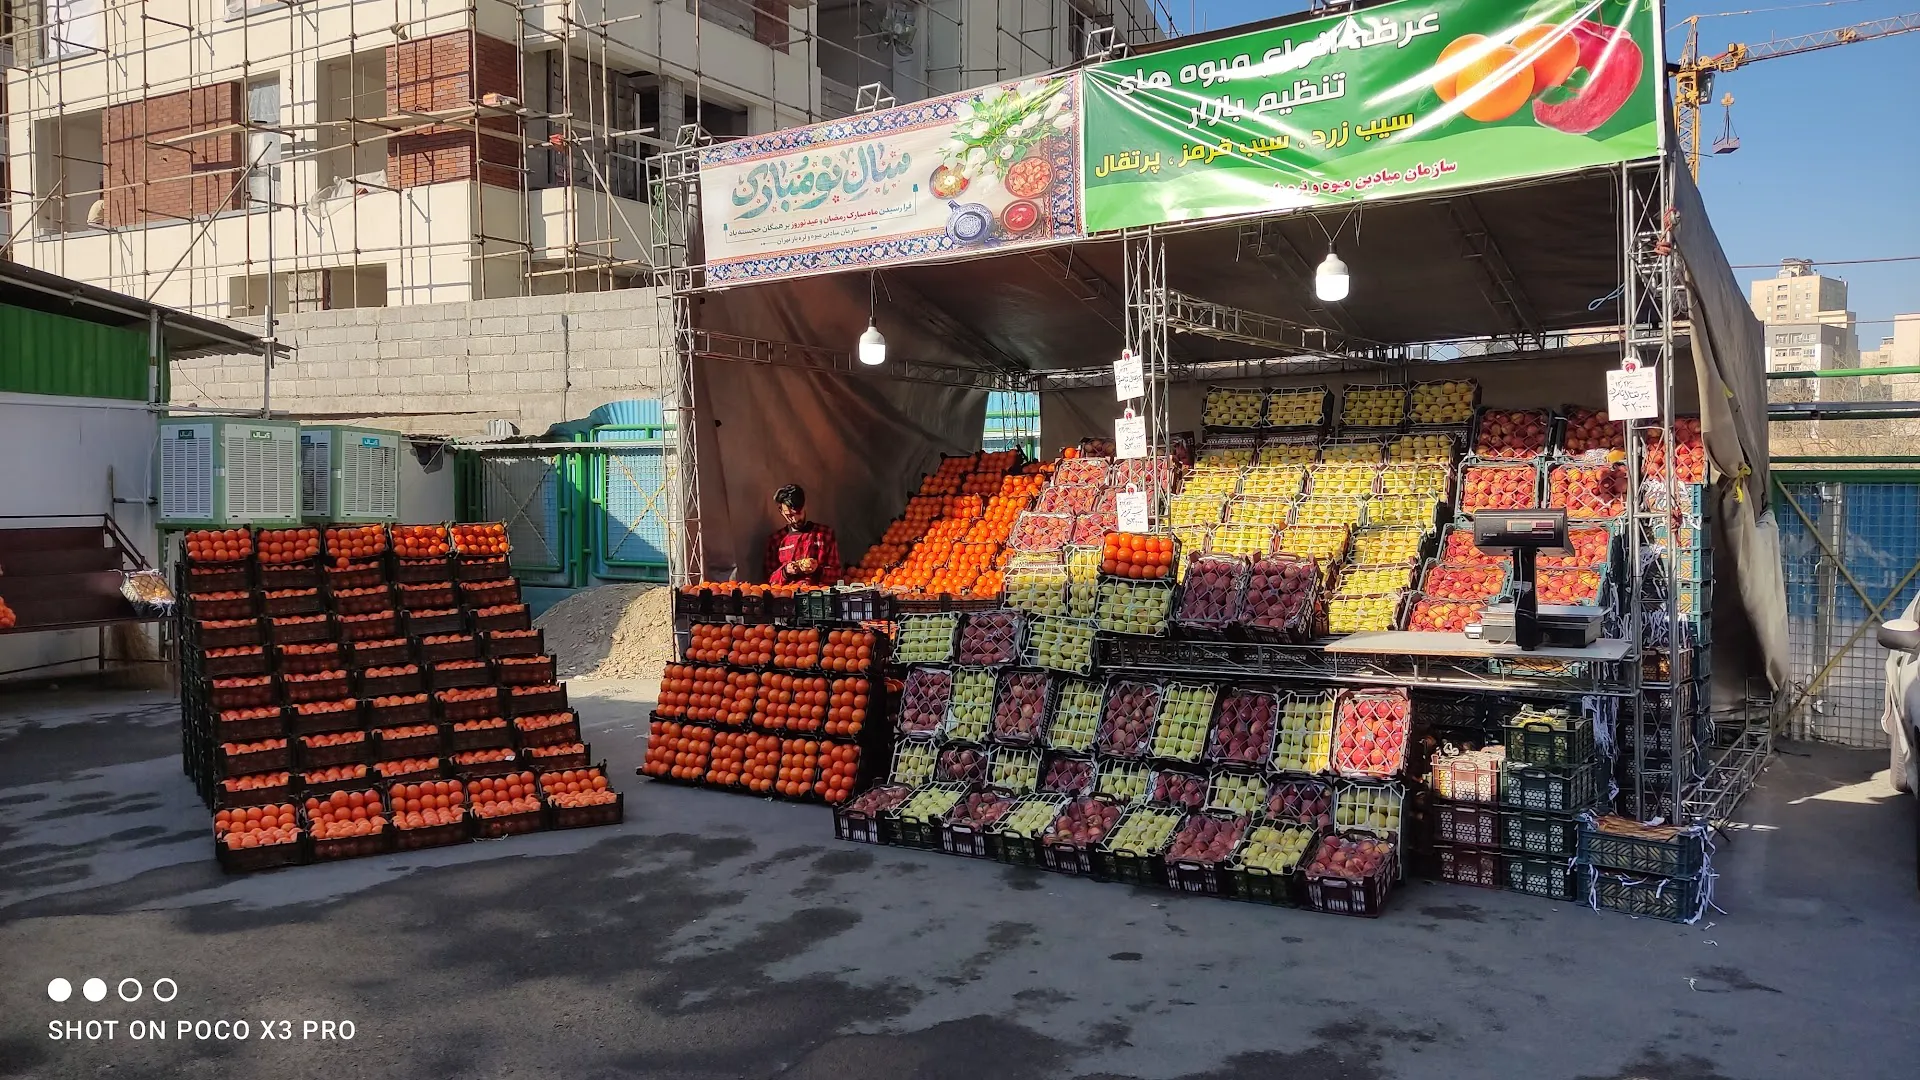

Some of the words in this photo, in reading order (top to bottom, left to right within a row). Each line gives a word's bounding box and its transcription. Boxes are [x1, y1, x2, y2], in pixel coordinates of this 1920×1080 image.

[1116, 68, 1173, 96] های
[1179, 53, 1251, 88] میوه
[1251, 72, 1347, 122] تنظیم
[1187, 94, 1245, 129] بازار
[1311, 120, 1349, 150] زرد
[1355, 113, 1415, 142] سیب
[1177, 137, 1234, 168] قرمز
[1239, 134, 1291, 158] سیب
[1095, 150, 1162, 178] پرتقال
[1405, 159, 1457, 183] سازمان
[1322, 179, 1351, 194] میوه
[1355, 169, 1400, 190] میادین
[791, 218, 807, 230] نوروز
[807, 219, 819, 227] عید
[823, 214, 846, 224] رمضان
[846, 211, 867, 221] مبارک
[867, 208, 879, 216] ماه
[762, 223, 783, 233] همگان
